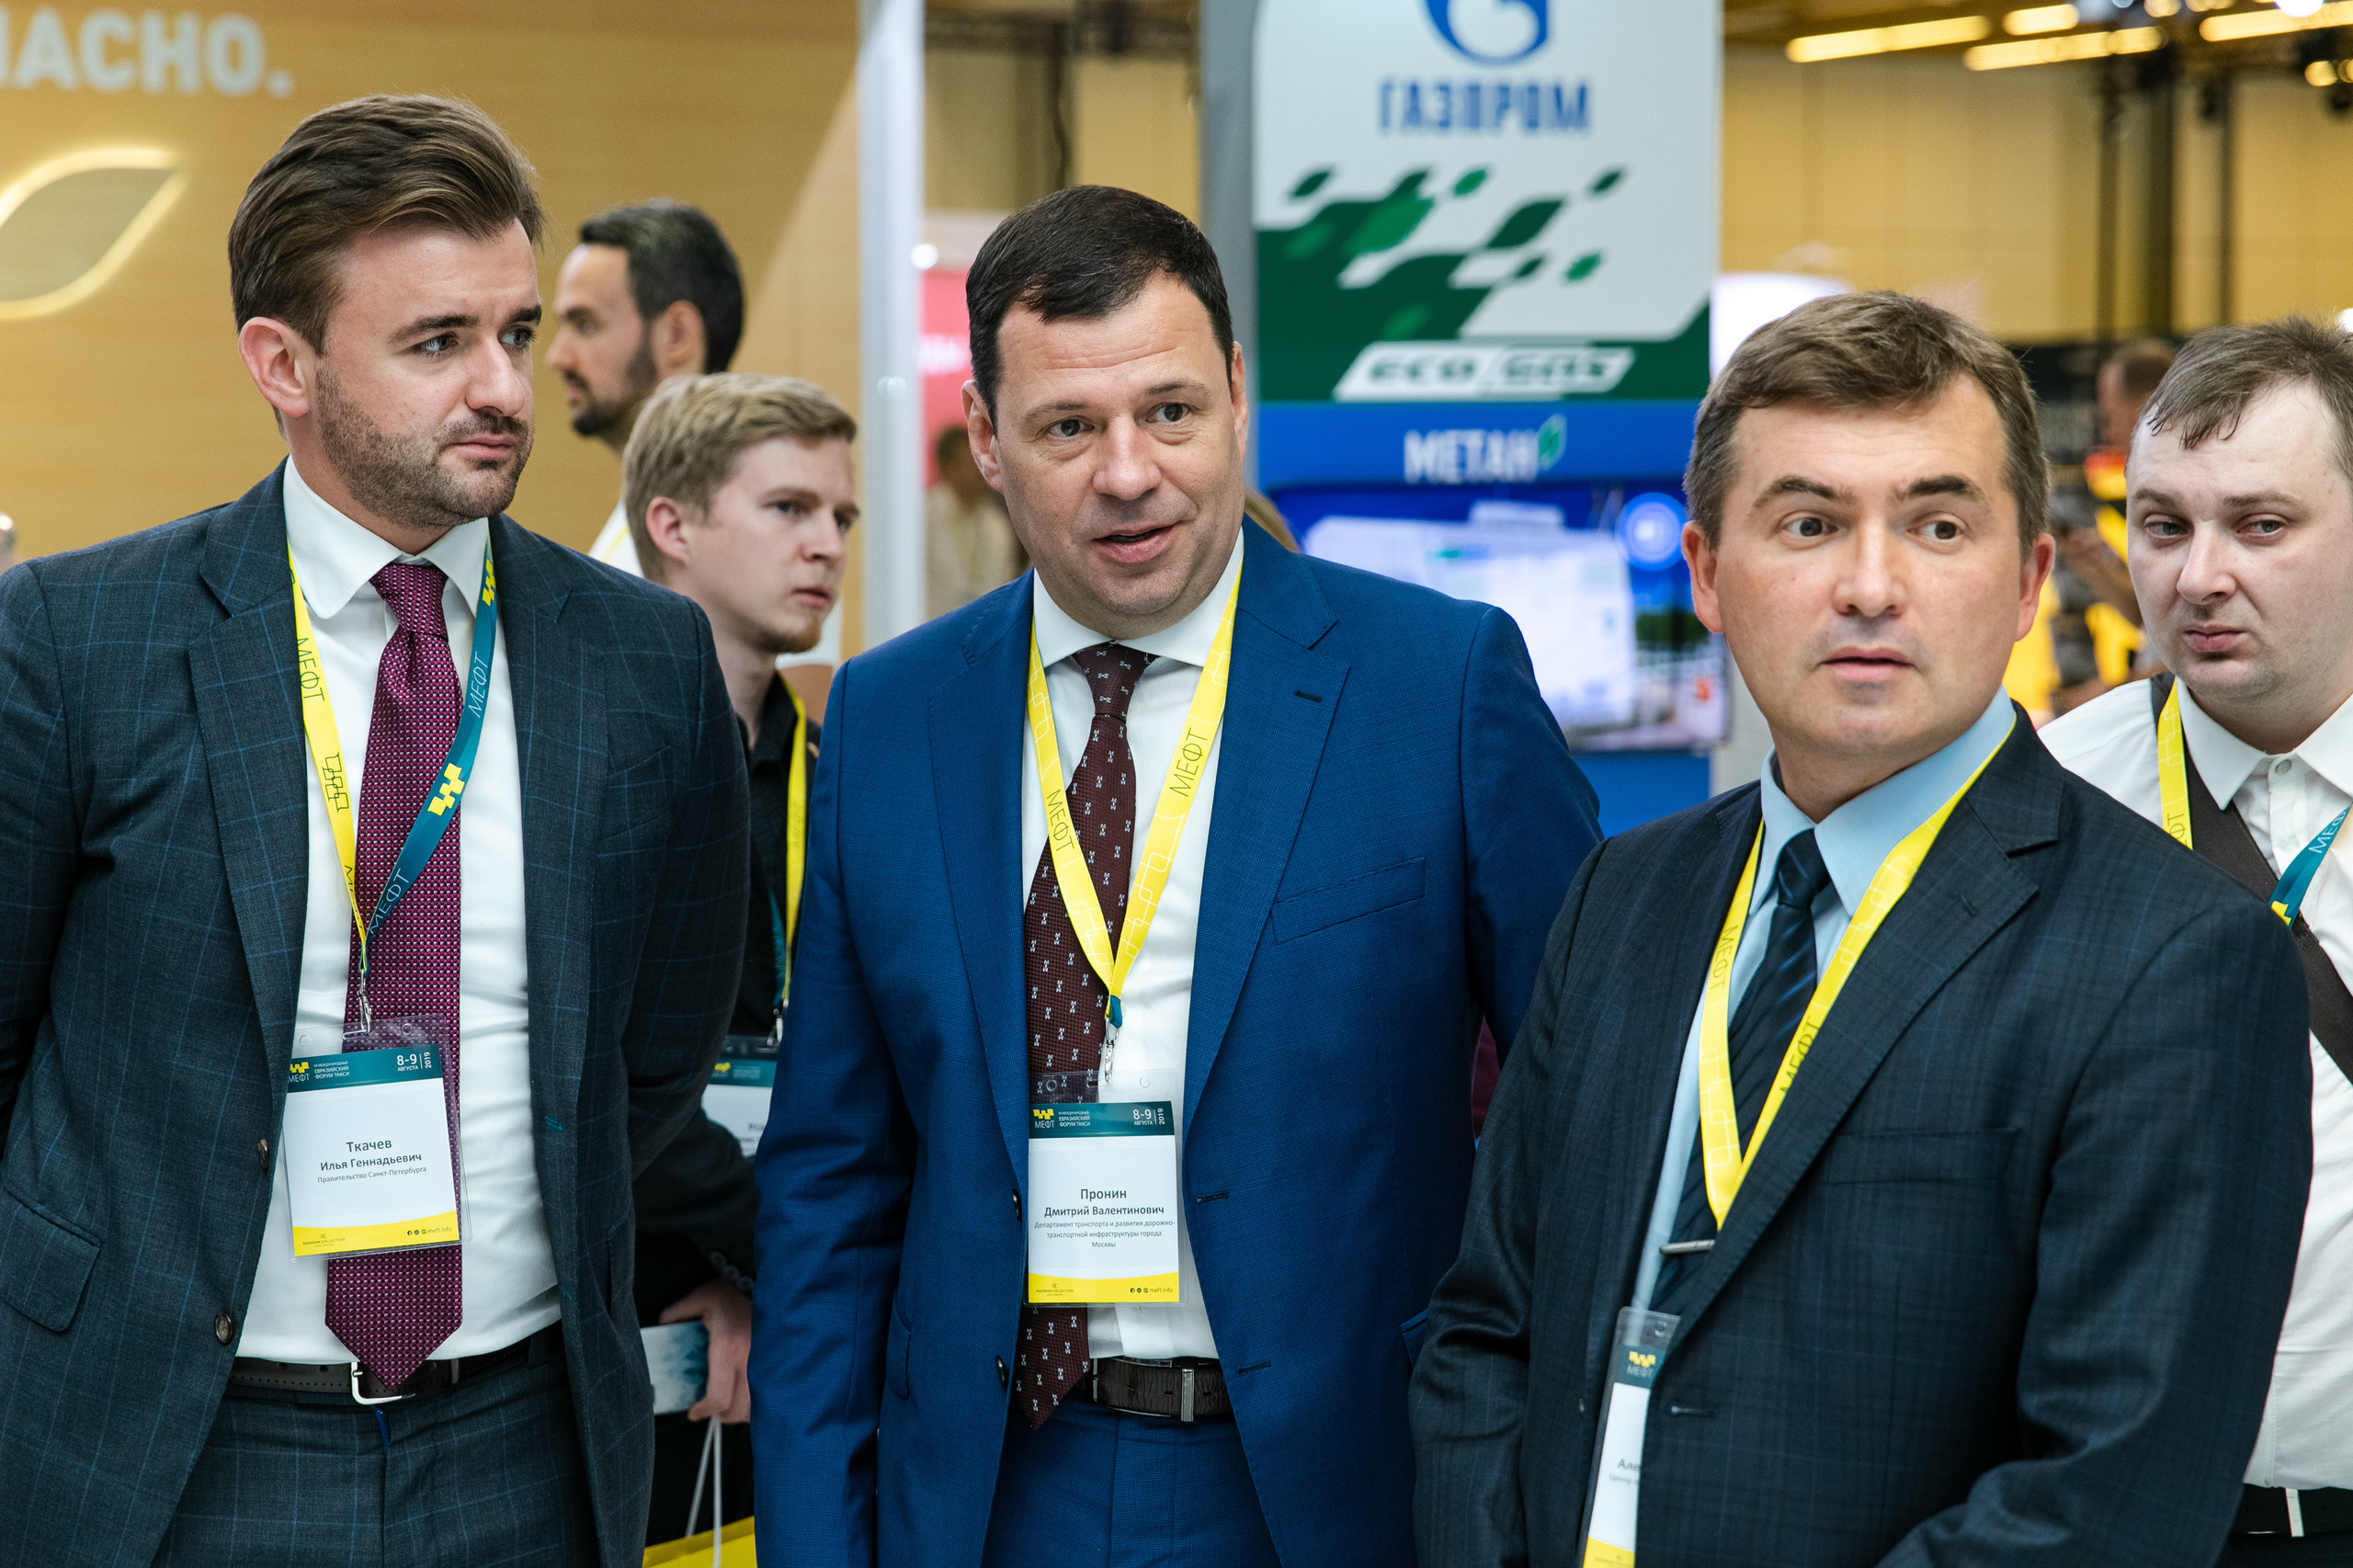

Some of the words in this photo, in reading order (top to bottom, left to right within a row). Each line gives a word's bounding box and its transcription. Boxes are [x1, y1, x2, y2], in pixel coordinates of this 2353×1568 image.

[1379, 79, 1592, 134] ГАЗПРОМ
[1404, 430, 1539, 483] МЕТАН
[396, 1053, 417, 1066] 8-9
[424, 1051, 432, 1069] 2019
[314, 1065, 349, 1074] ЕВРАЗИЙСКИЙ
[1132, 1108, 1152, 1120] 8-9
[1157, 1108, 1165, 1125] 2019
[346, 1139, 392, 1153] Ткачев
[320, 1160, 348, 1172] Илья
[350, 1153, 423, 1169] Геннадьевич
[317, 1172, 368, 1184] Правительство
[368, 1166, 427, 1179] Санкт-Петербурга
[1080, 1188, 1127, 1202] Пронин
[1044, 1206, 1090, 1218] Дмитрий
[1092, 1207, 1165, 1216] Валентинович
[427, 1225, 453, 1234] meft.info
[1034, 1221, 1074, 1231] Департамент
[1074, 1221, 1108, 1230] транспорта
[1115, 1221, 1143, 1229] развития
[1047, 1231, 1088, 1239] транспортной
[1089, 1230, 1140, 1239] инфраструктуры
